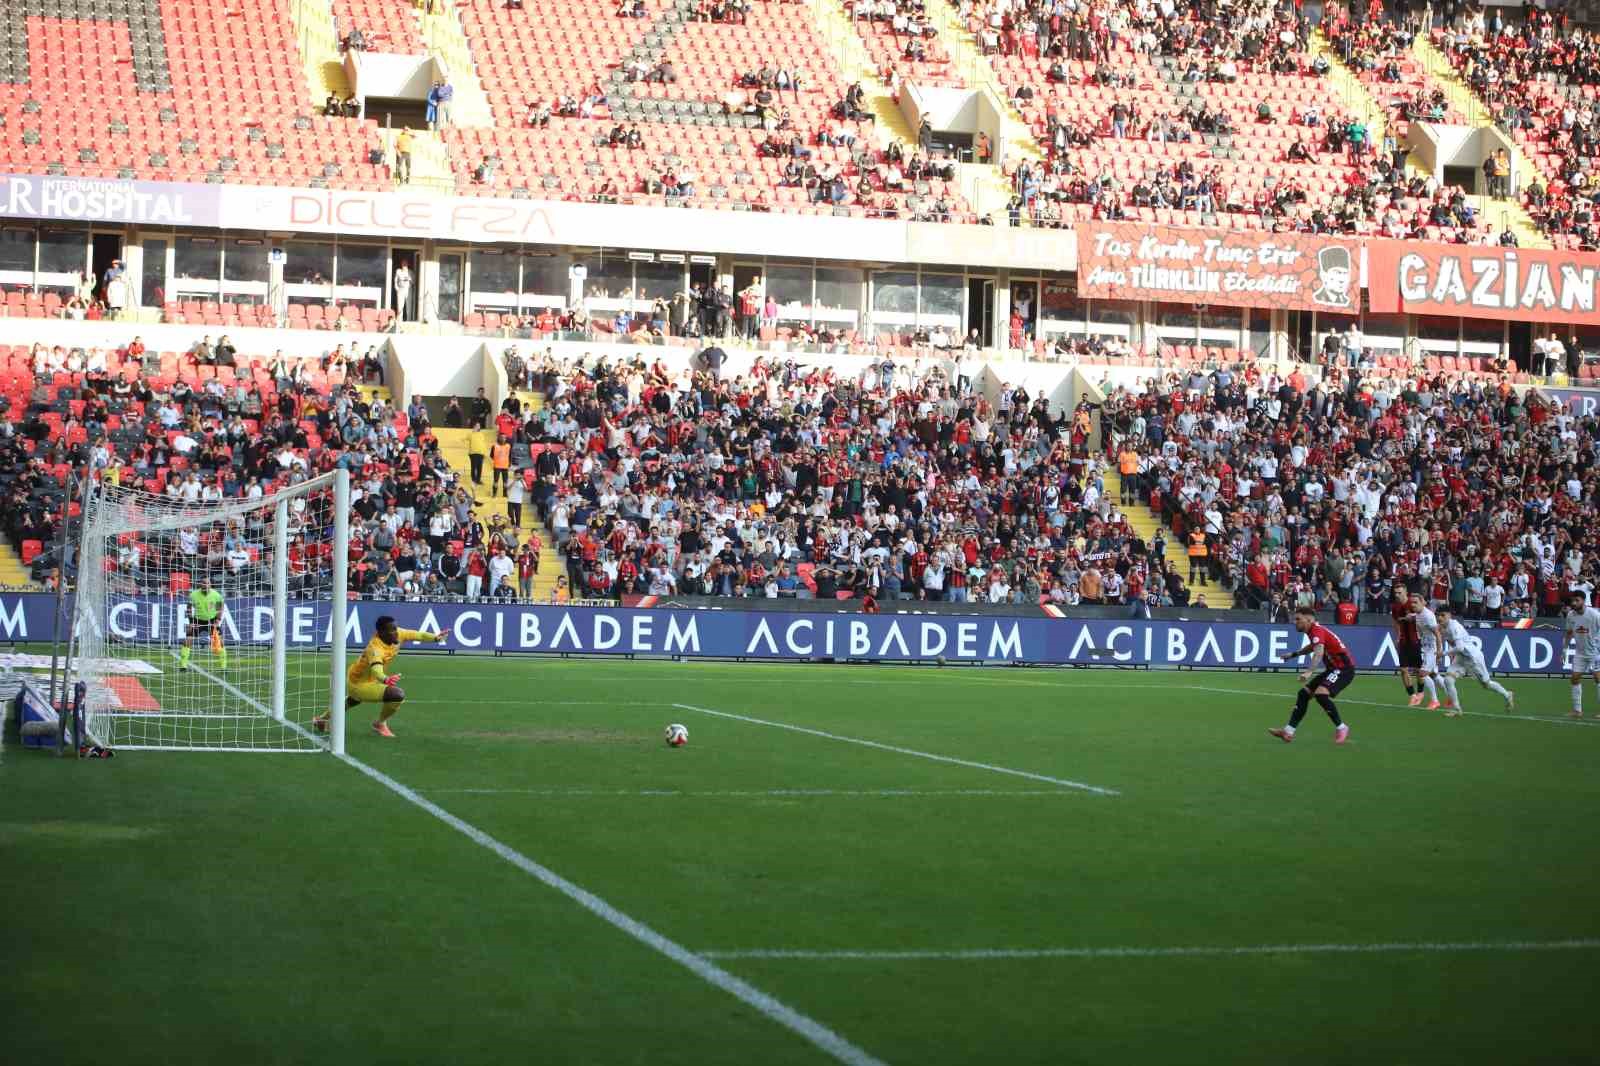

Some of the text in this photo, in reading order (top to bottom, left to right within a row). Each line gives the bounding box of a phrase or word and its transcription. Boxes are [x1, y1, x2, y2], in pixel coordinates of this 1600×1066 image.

[42, 180, 136, 192] INTERNATIONAL
[1204, 239, 1254, 268] Tunç
[411, 607, 701, 652] ACIBADEM
[746, 616, 1024, 659] ACIBADEM
